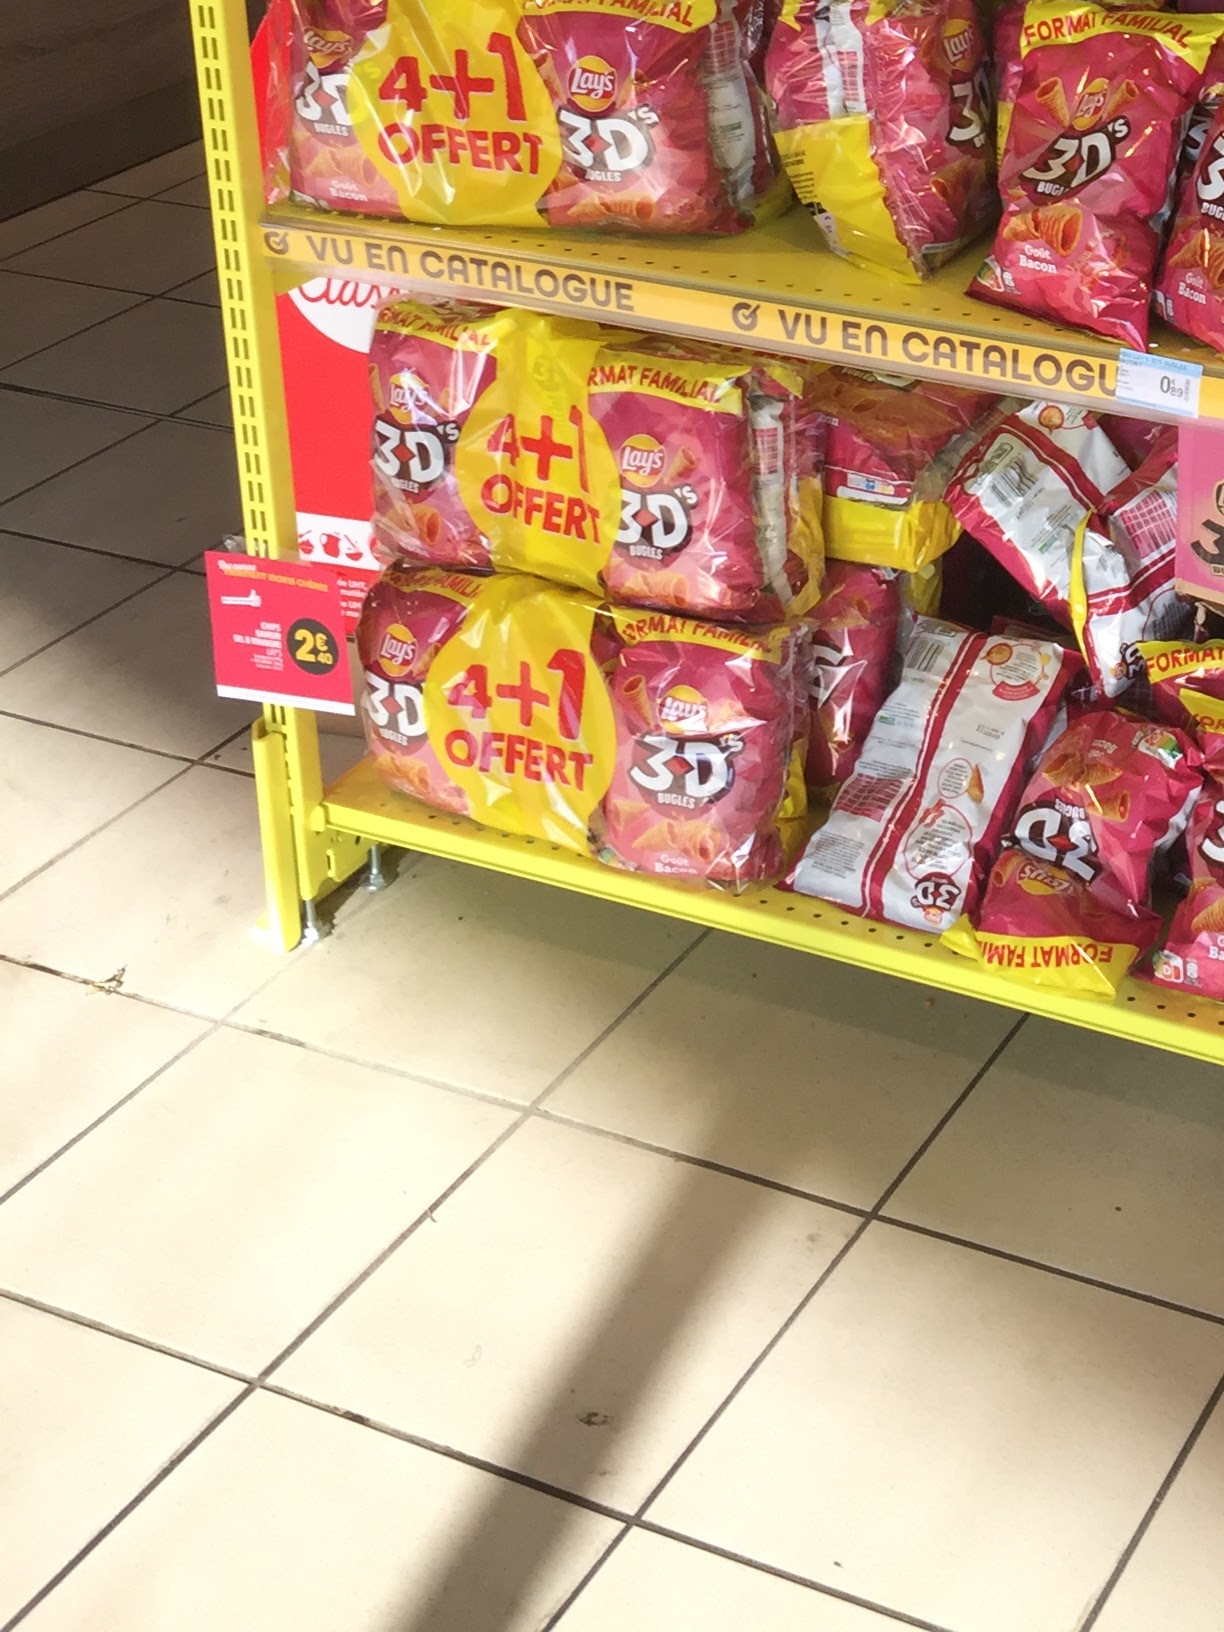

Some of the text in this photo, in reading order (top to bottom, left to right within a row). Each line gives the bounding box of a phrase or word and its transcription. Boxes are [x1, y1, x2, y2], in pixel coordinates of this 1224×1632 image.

[1023, 14, 1189, 45] FORMAT FAMILIAL
[378, 31, 527, 121] 4+1
[570, 70, 615, 93] Lay's
[379, 124, 541, 175] OFFERT
[1020, 256, 1057, 273] Bacon
[1024, 244, 1051, 259] Goût
[306, 235, 634, 311] VU EN CATALOGUE
[1179, 285, 1207, 305] Bacon
[779, 310, 827, 347] VU
[843, 322, 888, 357] EN
[901, 331, 1119, 396] CATALOGU
[641, 370, 719, 404] FAMILIAL
[488, 405, 589, 491] 4+1
[624, 448, 662, 470] Lay's
[480, 475, 602, 543] OFFERT
[629, 543, 663, 561] BUGLES
[380, 640, 415, 662] Lay's
[1147, 644, 1223, 676] FORMAT
[448, 649, 585, 740] 4+1
[445, 730, 594, 789] OFFERT
[657, 792, 695, 808] BUGLES
[1034, 945, 1113, 965] FORMAT
